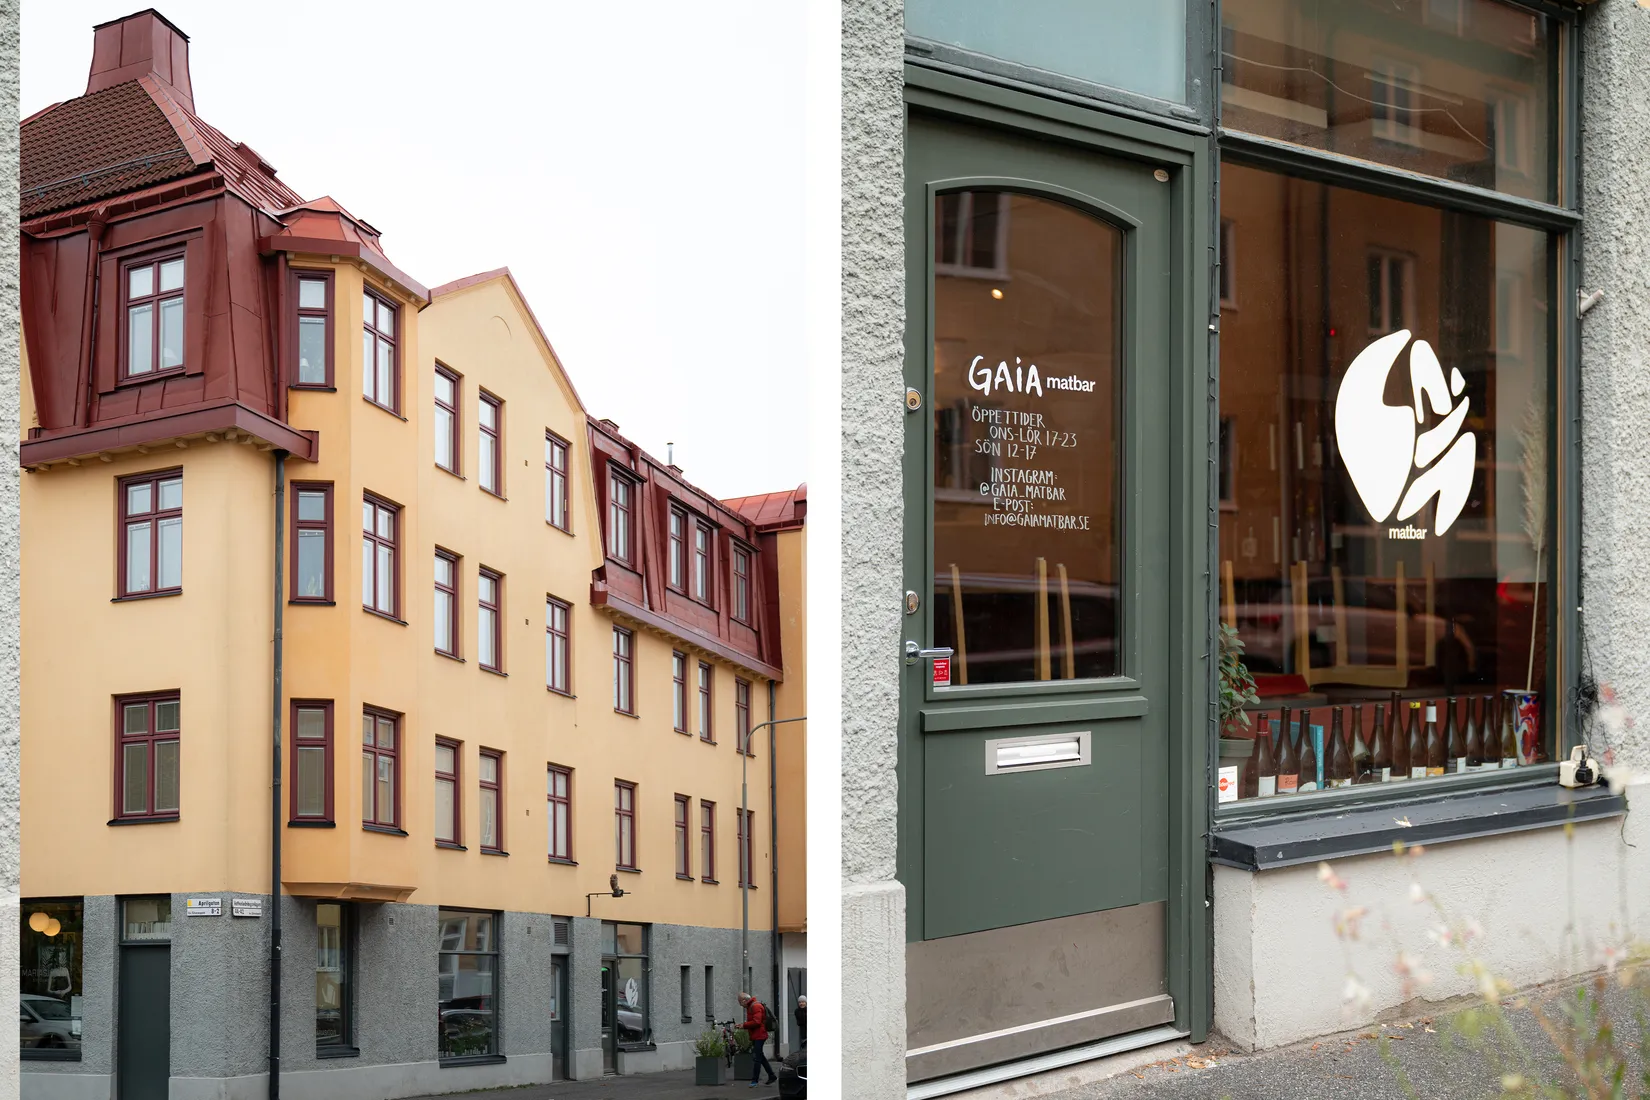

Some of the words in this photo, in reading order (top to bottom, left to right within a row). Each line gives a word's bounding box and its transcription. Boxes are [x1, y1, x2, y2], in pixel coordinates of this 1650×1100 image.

[1046, 375, 1095, 392] matbar
[971, 406, 1045, 428] ÖPPETTIDER
[989, 425, 1042, 446] ONS-LÖR
[1046, 431, 1077, 448] 17-23
[974, 438, 1001, 457] SÖN
[1007, 443, 1037, 460] 12-17
[990, 467, 1058, 485] INSTAGRAM:
[993, 498, 1034, 513] E-POST:
[984, 513, 1090, 531] INFO@GAIAMATBAR.SE
[1388, 524, 1427, 540] matbar
